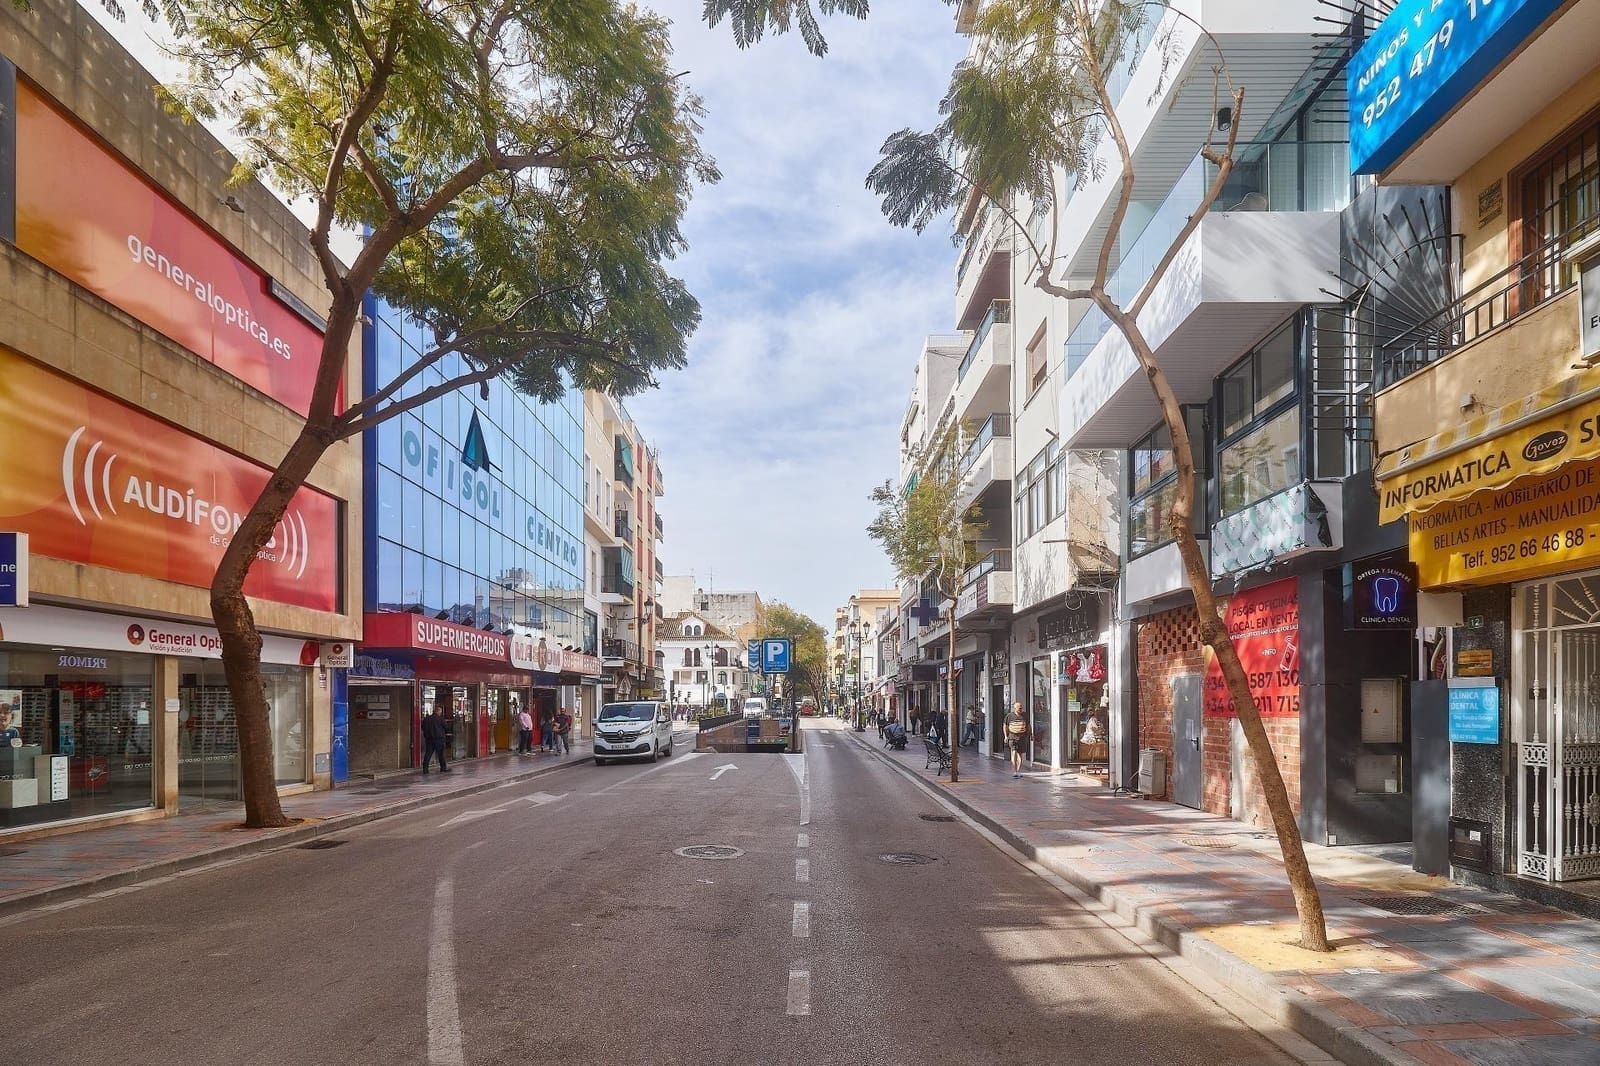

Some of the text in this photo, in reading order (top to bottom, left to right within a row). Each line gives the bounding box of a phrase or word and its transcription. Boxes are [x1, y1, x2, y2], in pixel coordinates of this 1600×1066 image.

[1413, 8, 1424, 28] Y
[1361, 75, 1400, 130] 952
[1409, 19, 1454, 80] 479
[127, 234, 291, 360] generaloptica.es
[1525, 435, 1567, 459] Govoz
[1385, 450, 1511, 508] INFORMATICA
[1576, 466, 1594, 488] DE
[403, 430, 577, 567] OFISOL CENTRO
[209, 534, 220, 546] de
[1434, 528, 1469, 550] BELLAS
[1472, 518, 1507, 544] ARTES
[1462, 527, 1584, 570] Telf. 952 66 46 88
[1229, 620, 1255, 633] LOCAL
[1256, 617, 1268, 630] EN
[149, 629, 224, 652] General Opti
[417, 620, 505, 657] SUPERMERCADOS
[767, 642, 784, 662] P
[1250, 672, 1273, 689] 587
[1276, 669, 1299, 687] 130
[1277, 695, 1300, 712] 715
